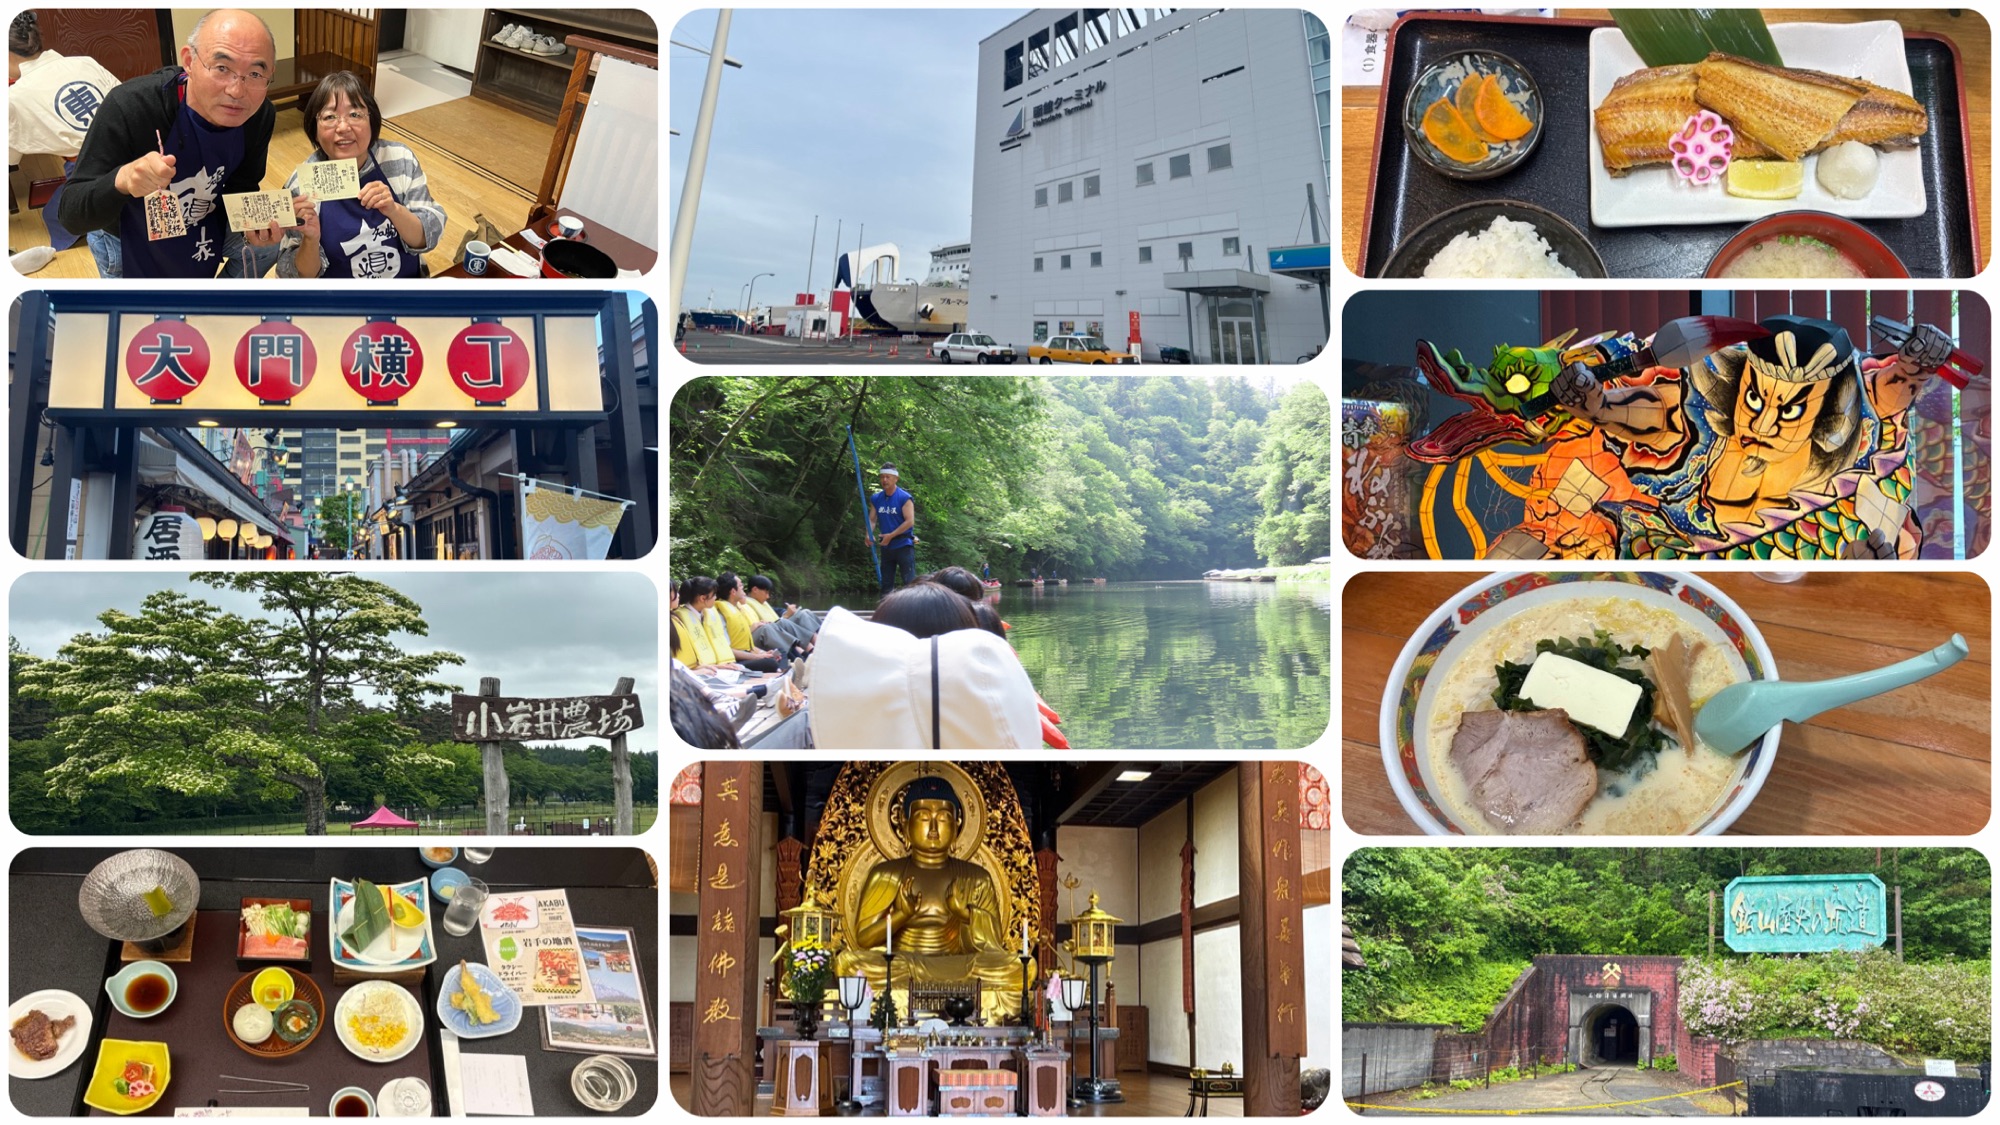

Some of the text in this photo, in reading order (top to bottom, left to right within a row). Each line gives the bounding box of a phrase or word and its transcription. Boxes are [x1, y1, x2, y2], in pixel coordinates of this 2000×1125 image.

[1033, 80, 1106, 119] 函館ターミナル
[1033, 99, 1093, 127] Hakodate Terminal
[135, 333, 512, 388] 大門横丁
[1342, 416, 1378, 449] 青森
[465, 698, 635, 738] 小岩井農場
[538, 899, 565, 908] AKABU
[523, 936, 573, 948] 岩手の地酒
